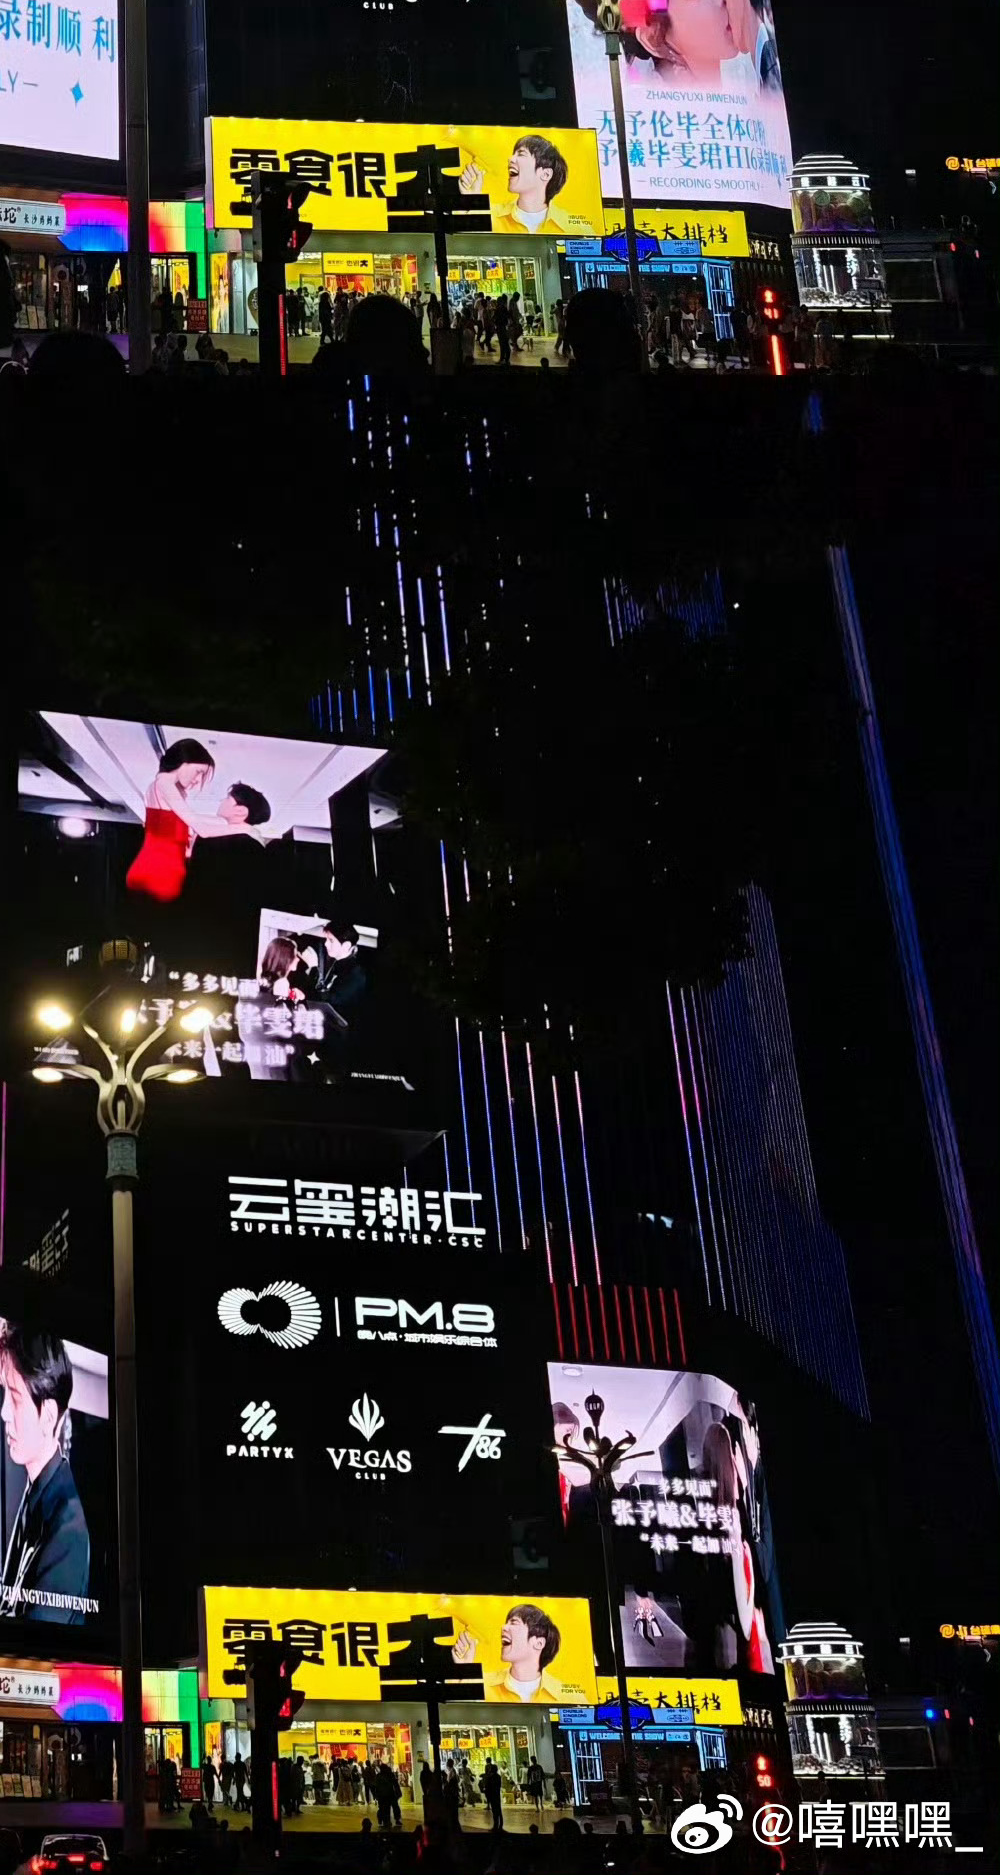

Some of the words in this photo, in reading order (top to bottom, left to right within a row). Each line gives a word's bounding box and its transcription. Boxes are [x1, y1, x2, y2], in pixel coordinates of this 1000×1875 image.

[363, 2, 394, 11] CLUB
[646, 90, 704, 103] ZHANGYUXI
[650, 176, 712, 190] RECORDING
[355, 1297, 494, 1333] PM.8
[226, 1444, 294, 1459] PARTYK
[327, 1447, 412, 1474] VEGAS
[355, 1472, 386, 1481] CLUB
